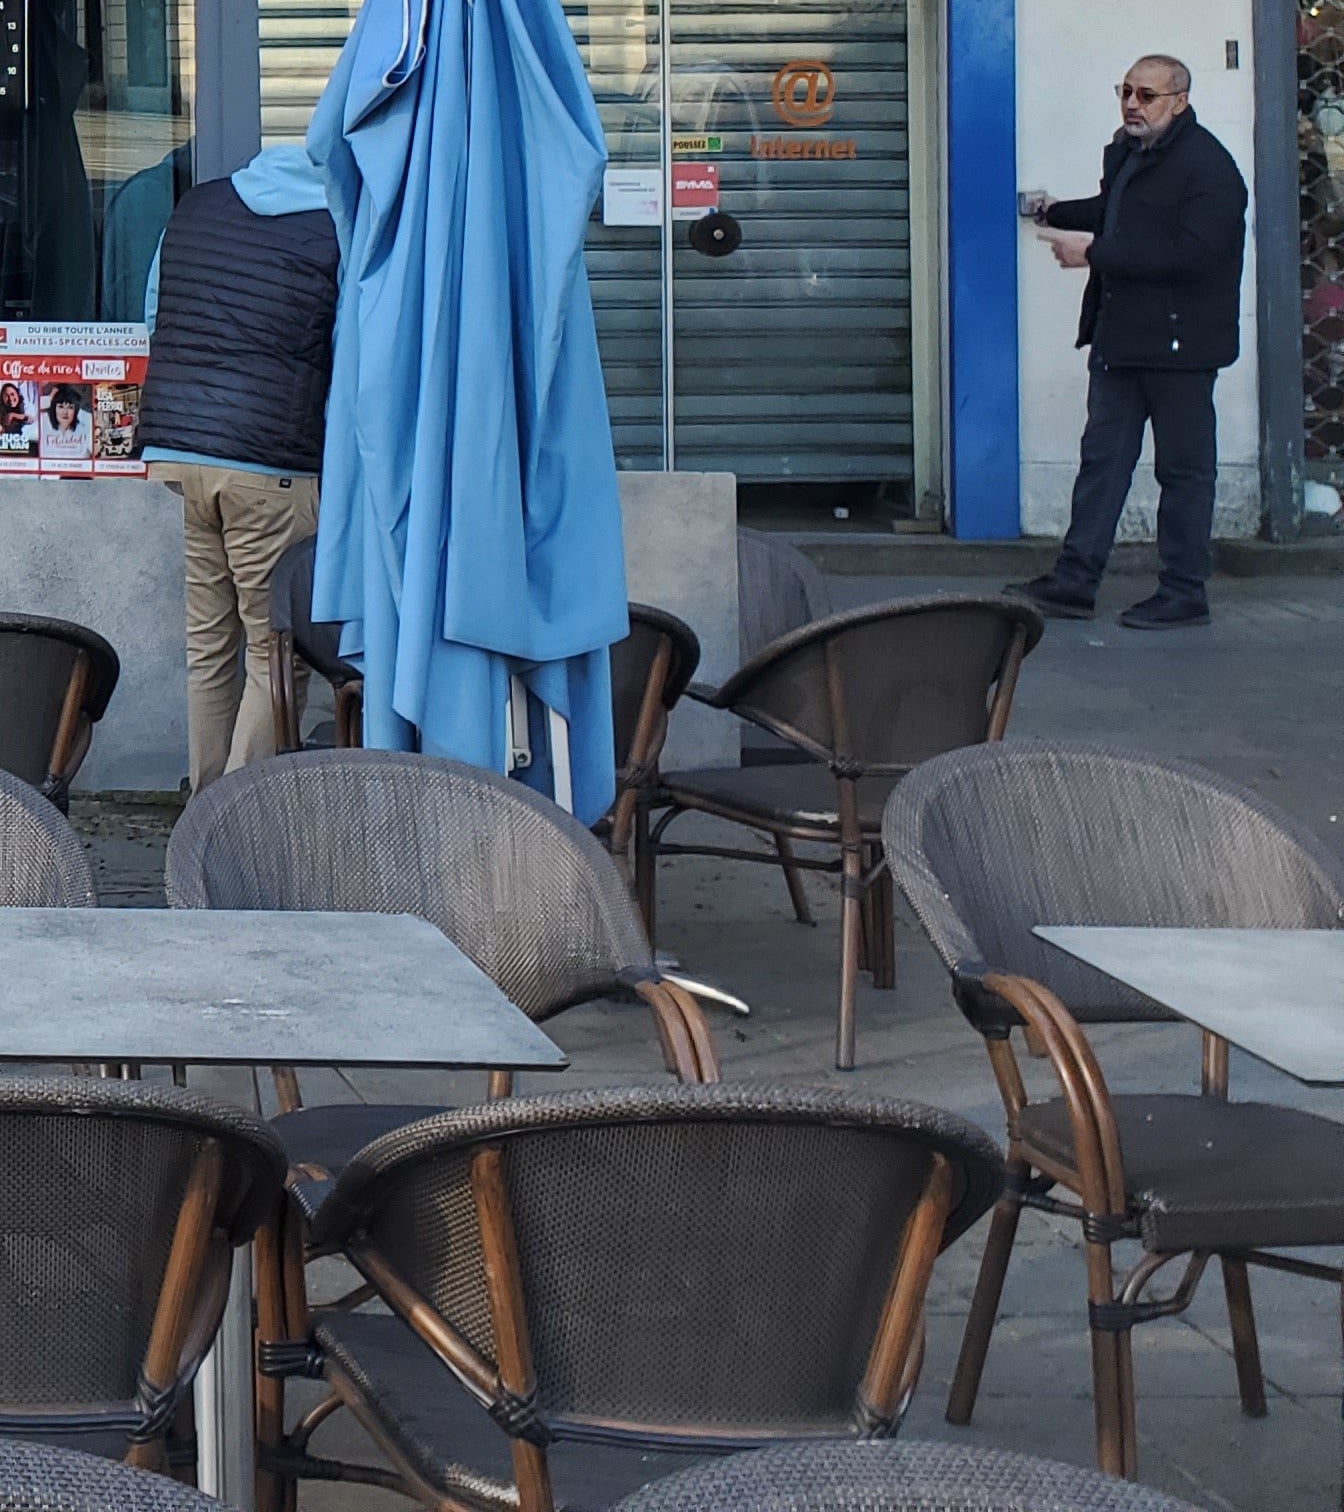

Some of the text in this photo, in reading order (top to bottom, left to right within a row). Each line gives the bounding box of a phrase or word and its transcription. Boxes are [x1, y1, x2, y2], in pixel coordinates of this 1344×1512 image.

[7, 21, 16, 30] 13
[11, 43, 19, 53] 6
[7, 66, 16, 75] 10
[673, 139, 706, 150] POUSSEZ
[27, 326, 41, 334] DU
[43, 326, 63, 335] RIRE
[65, 326, 94, 335] TOUTE
[14, 337, 148, 347] NANTES-SPECTACLES.COM
[2, 360, 35, 379] Offrez
[37, 364, 51, 375] du
[84, 362, 123, 377] Nantes
